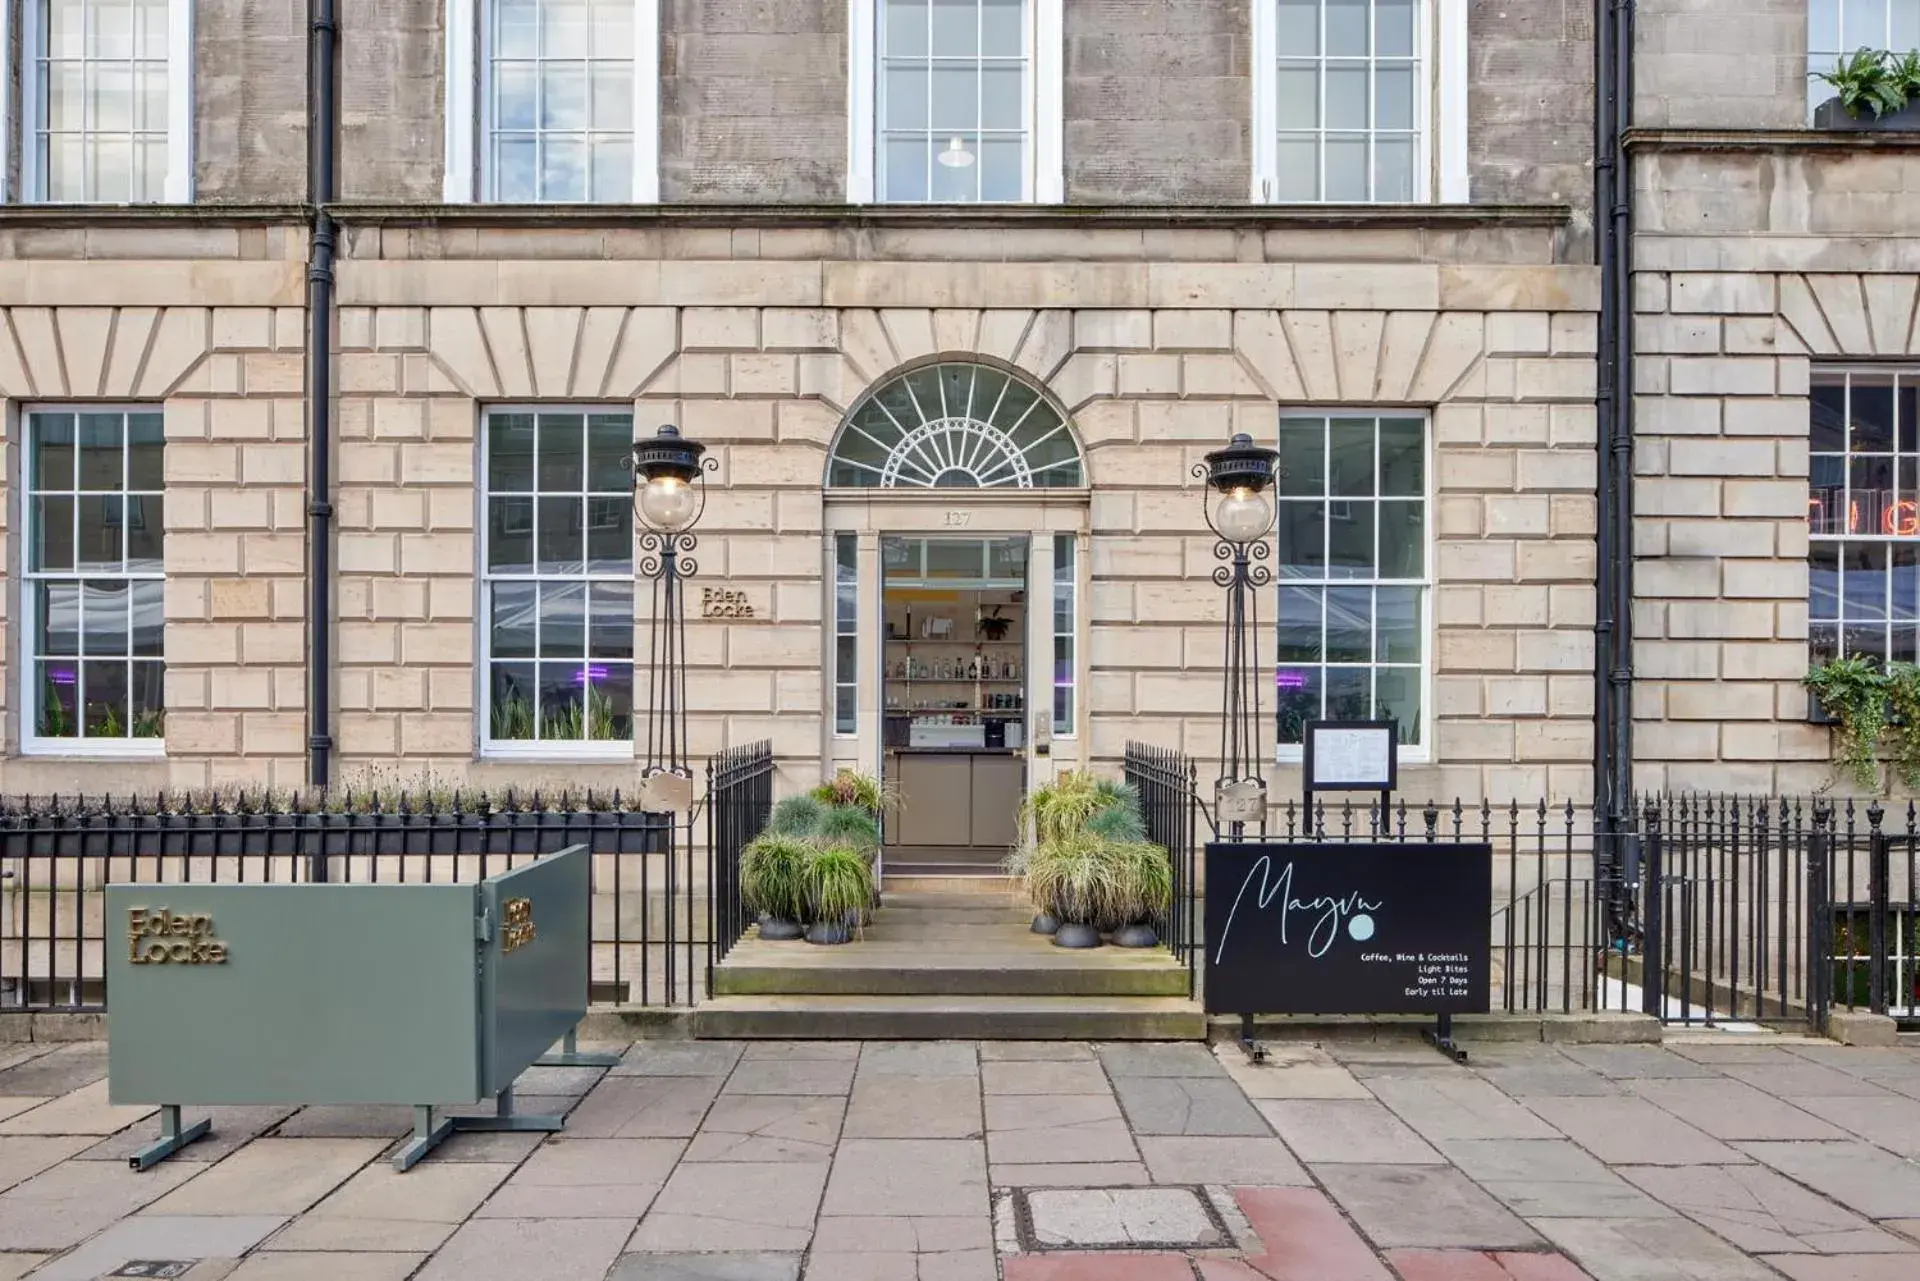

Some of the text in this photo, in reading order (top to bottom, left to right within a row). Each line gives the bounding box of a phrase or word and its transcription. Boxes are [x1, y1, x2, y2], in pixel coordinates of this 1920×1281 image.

[943, 511, 972, 526] 127
[702, 587, 748, 603] Eden
[702, 600, 754, 618] Locke
[127, 906, 214, 937] Eden
[127, 934, 230, 965] Locke
[1360, 952, 1469, 963] Coffee, Wine & Cocktails
[1418, 964, 1468, 975] Light Bites
[1417, 976, 1468, 986] Open 7 Days
[1404, 987, 1428, 997] Early
[1449, 987, 1468, 996] Late
